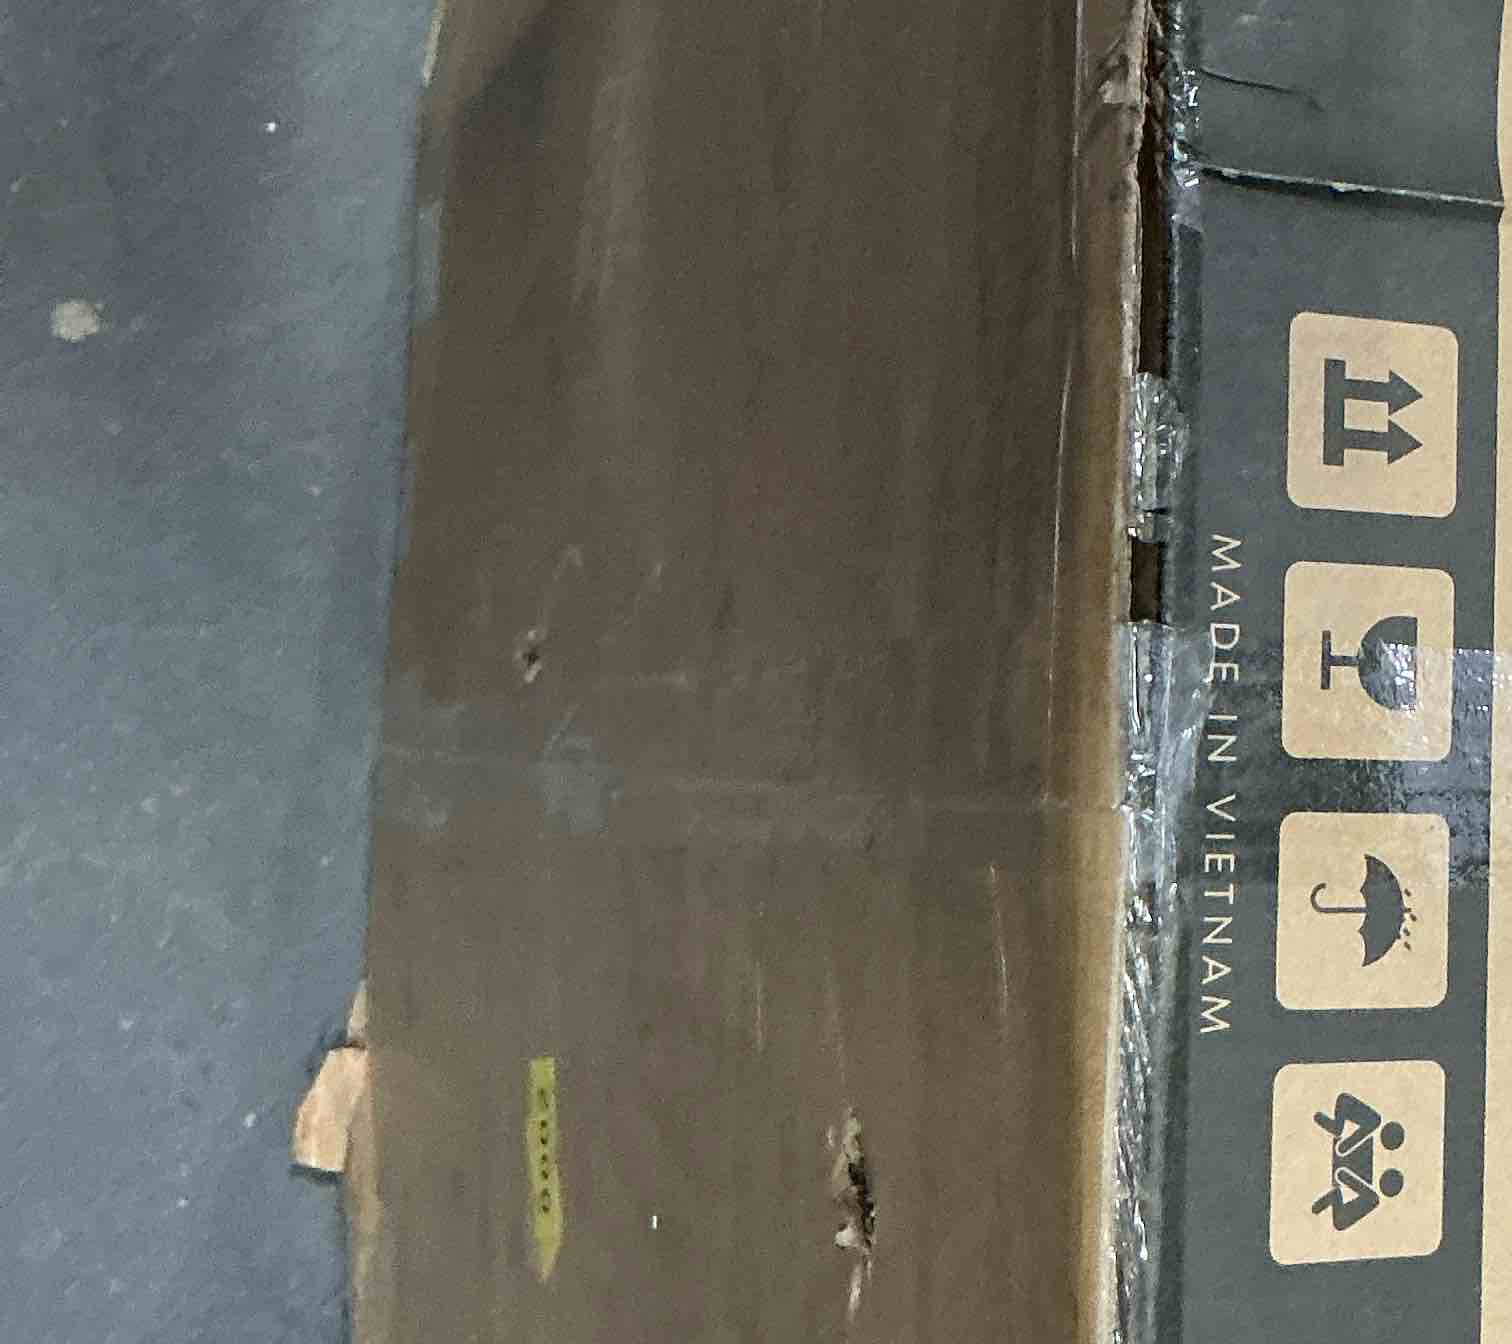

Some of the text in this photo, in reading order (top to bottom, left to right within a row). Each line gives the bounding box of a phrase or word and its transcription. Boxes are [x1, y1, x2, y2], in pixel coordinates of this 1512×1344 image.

[1198, 534, 1242, 1035] MADE IN VIETNAM
